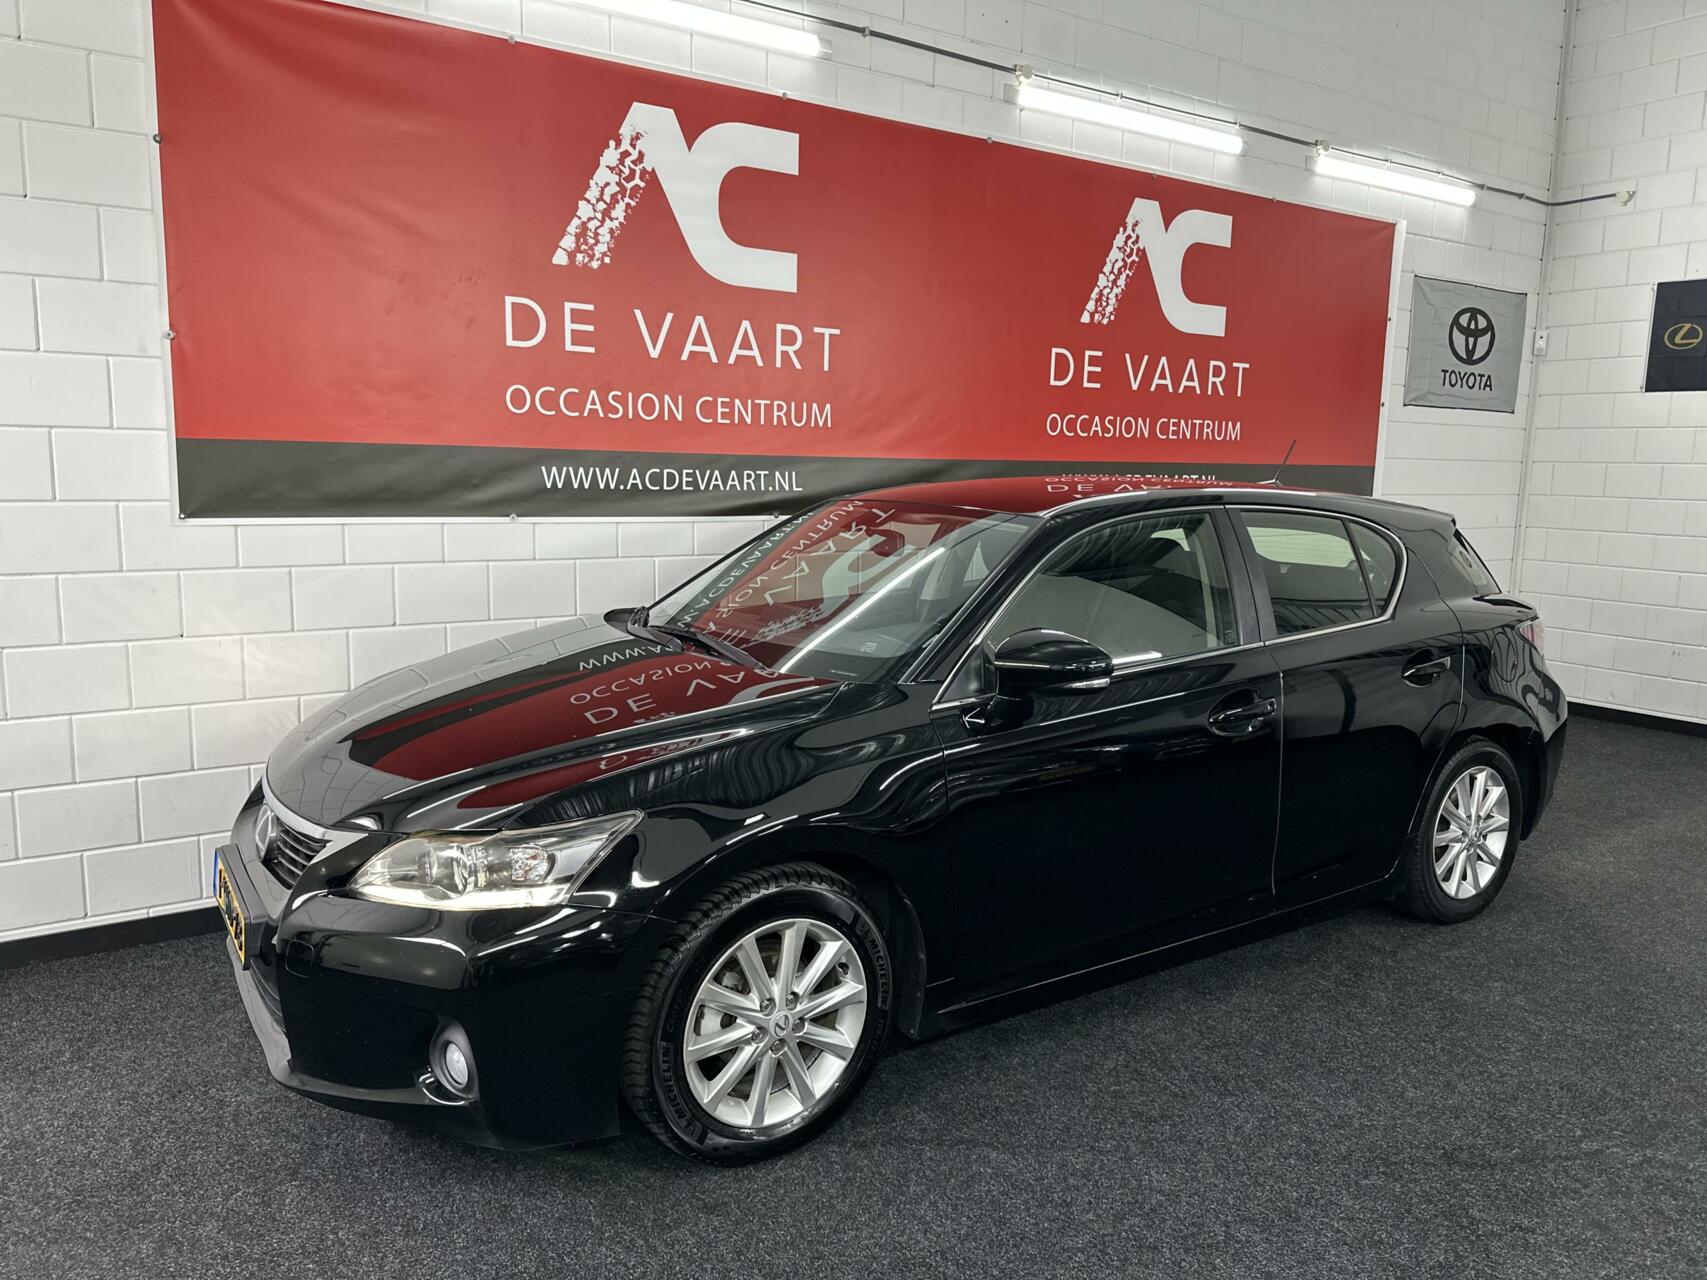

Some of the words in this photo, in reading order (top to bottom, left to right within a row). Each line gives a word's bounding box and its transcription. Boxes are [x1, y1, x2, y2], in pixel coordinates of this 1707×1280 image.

[505, 295, 596, 353] DE
[633, 308, 841, 371] VAART
[1050, 347, 1102, 388] DE
[1125, 353, 1249, 397] VAART
[1440, 368, 1493, 391] TOYOTA
[505, 384, 683, 422] OCCASION
[695, 396, 833, 428] CENTRUM
[1046, 413, 1149, 438] OCCASION
[1156, 417, 1240, 441] CENTRUM
[541, 465, 803, 492] WWW.ACDEVAART.NL
[868, 938, 889, 1007] MICHELIN
[662, 1047, 687, 1121] MICHELIN
